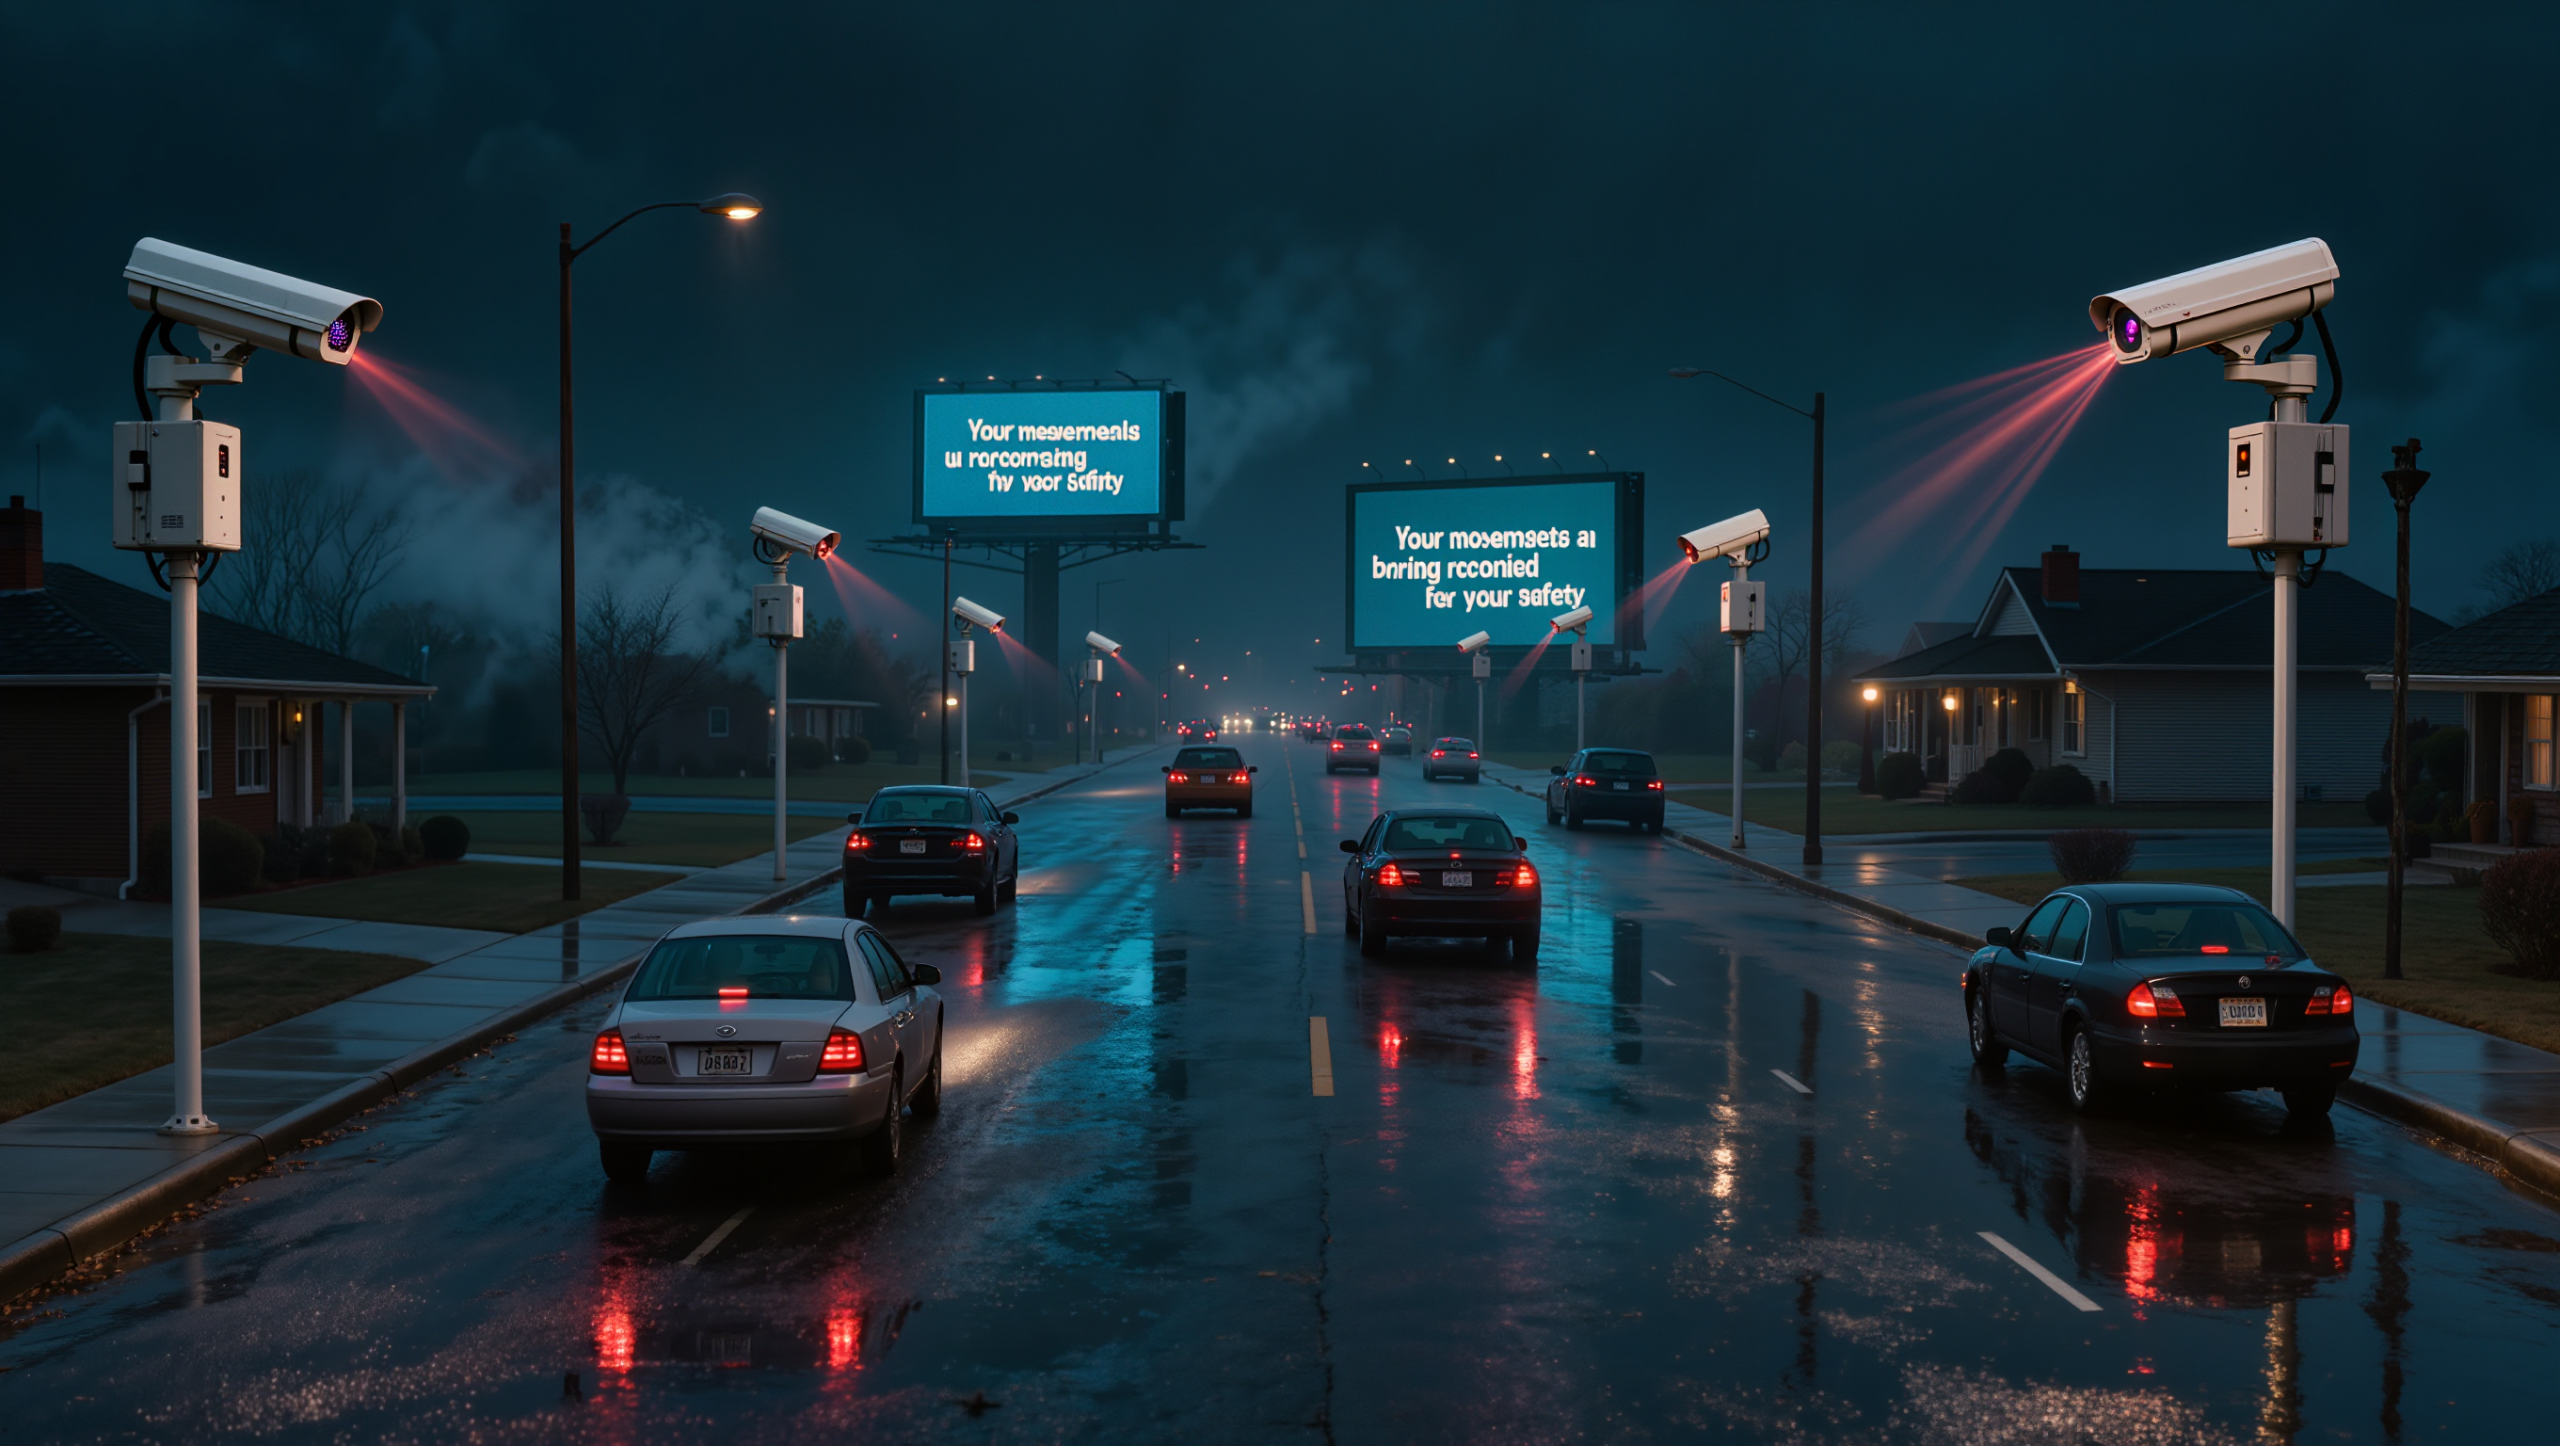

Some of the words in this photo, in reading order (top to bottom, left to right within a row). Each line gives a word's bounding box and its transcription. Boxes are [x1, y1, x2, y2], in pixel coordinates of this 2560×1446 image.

[968, 419, 1015, 441] Your
[1396, 526, 1445, 550] Your
[1463, 590, 1514, 612] your
